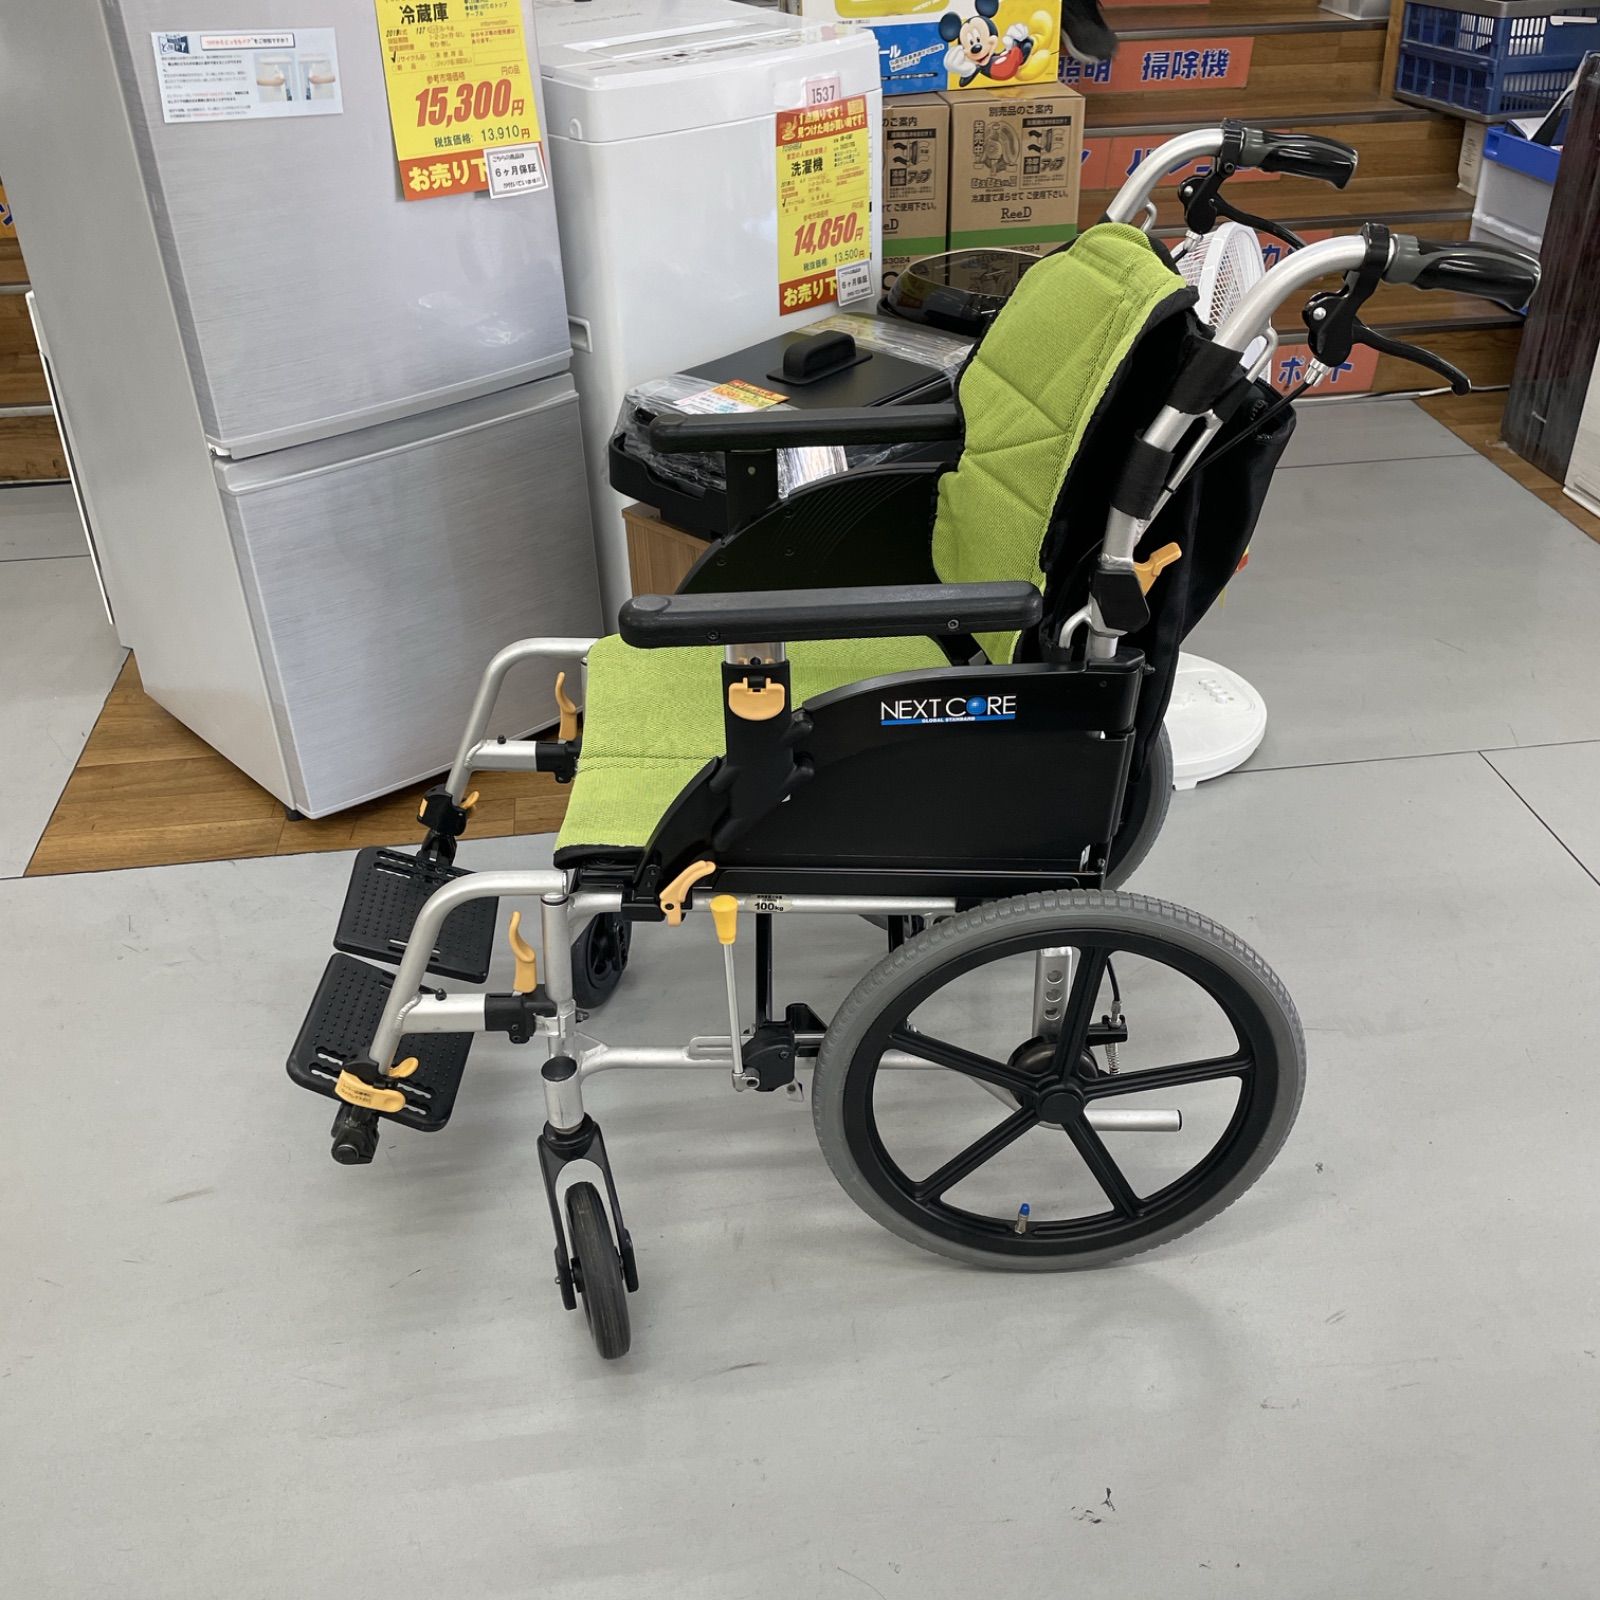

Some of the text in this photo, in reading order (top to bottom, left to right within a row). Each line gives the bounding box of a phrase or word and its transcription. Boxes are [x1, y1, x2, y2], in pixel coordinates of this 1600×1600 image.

[399, 2, 449, 25] 冷蔵庫
[1142, 49, 1231, 81] 掃除機
[415, 78, 525, 127] 15,300円
[811, 85, 835, 104] 1537
[988, 104, 1054, 117] 別売品のご案内
[791, 157, 824, 177] 洗濯機
[1001, 206, 1032, 219] ReeD
[1278, 356, 1354, 385] ポト
[881, 695, 1017, 720] NEXT CORE
